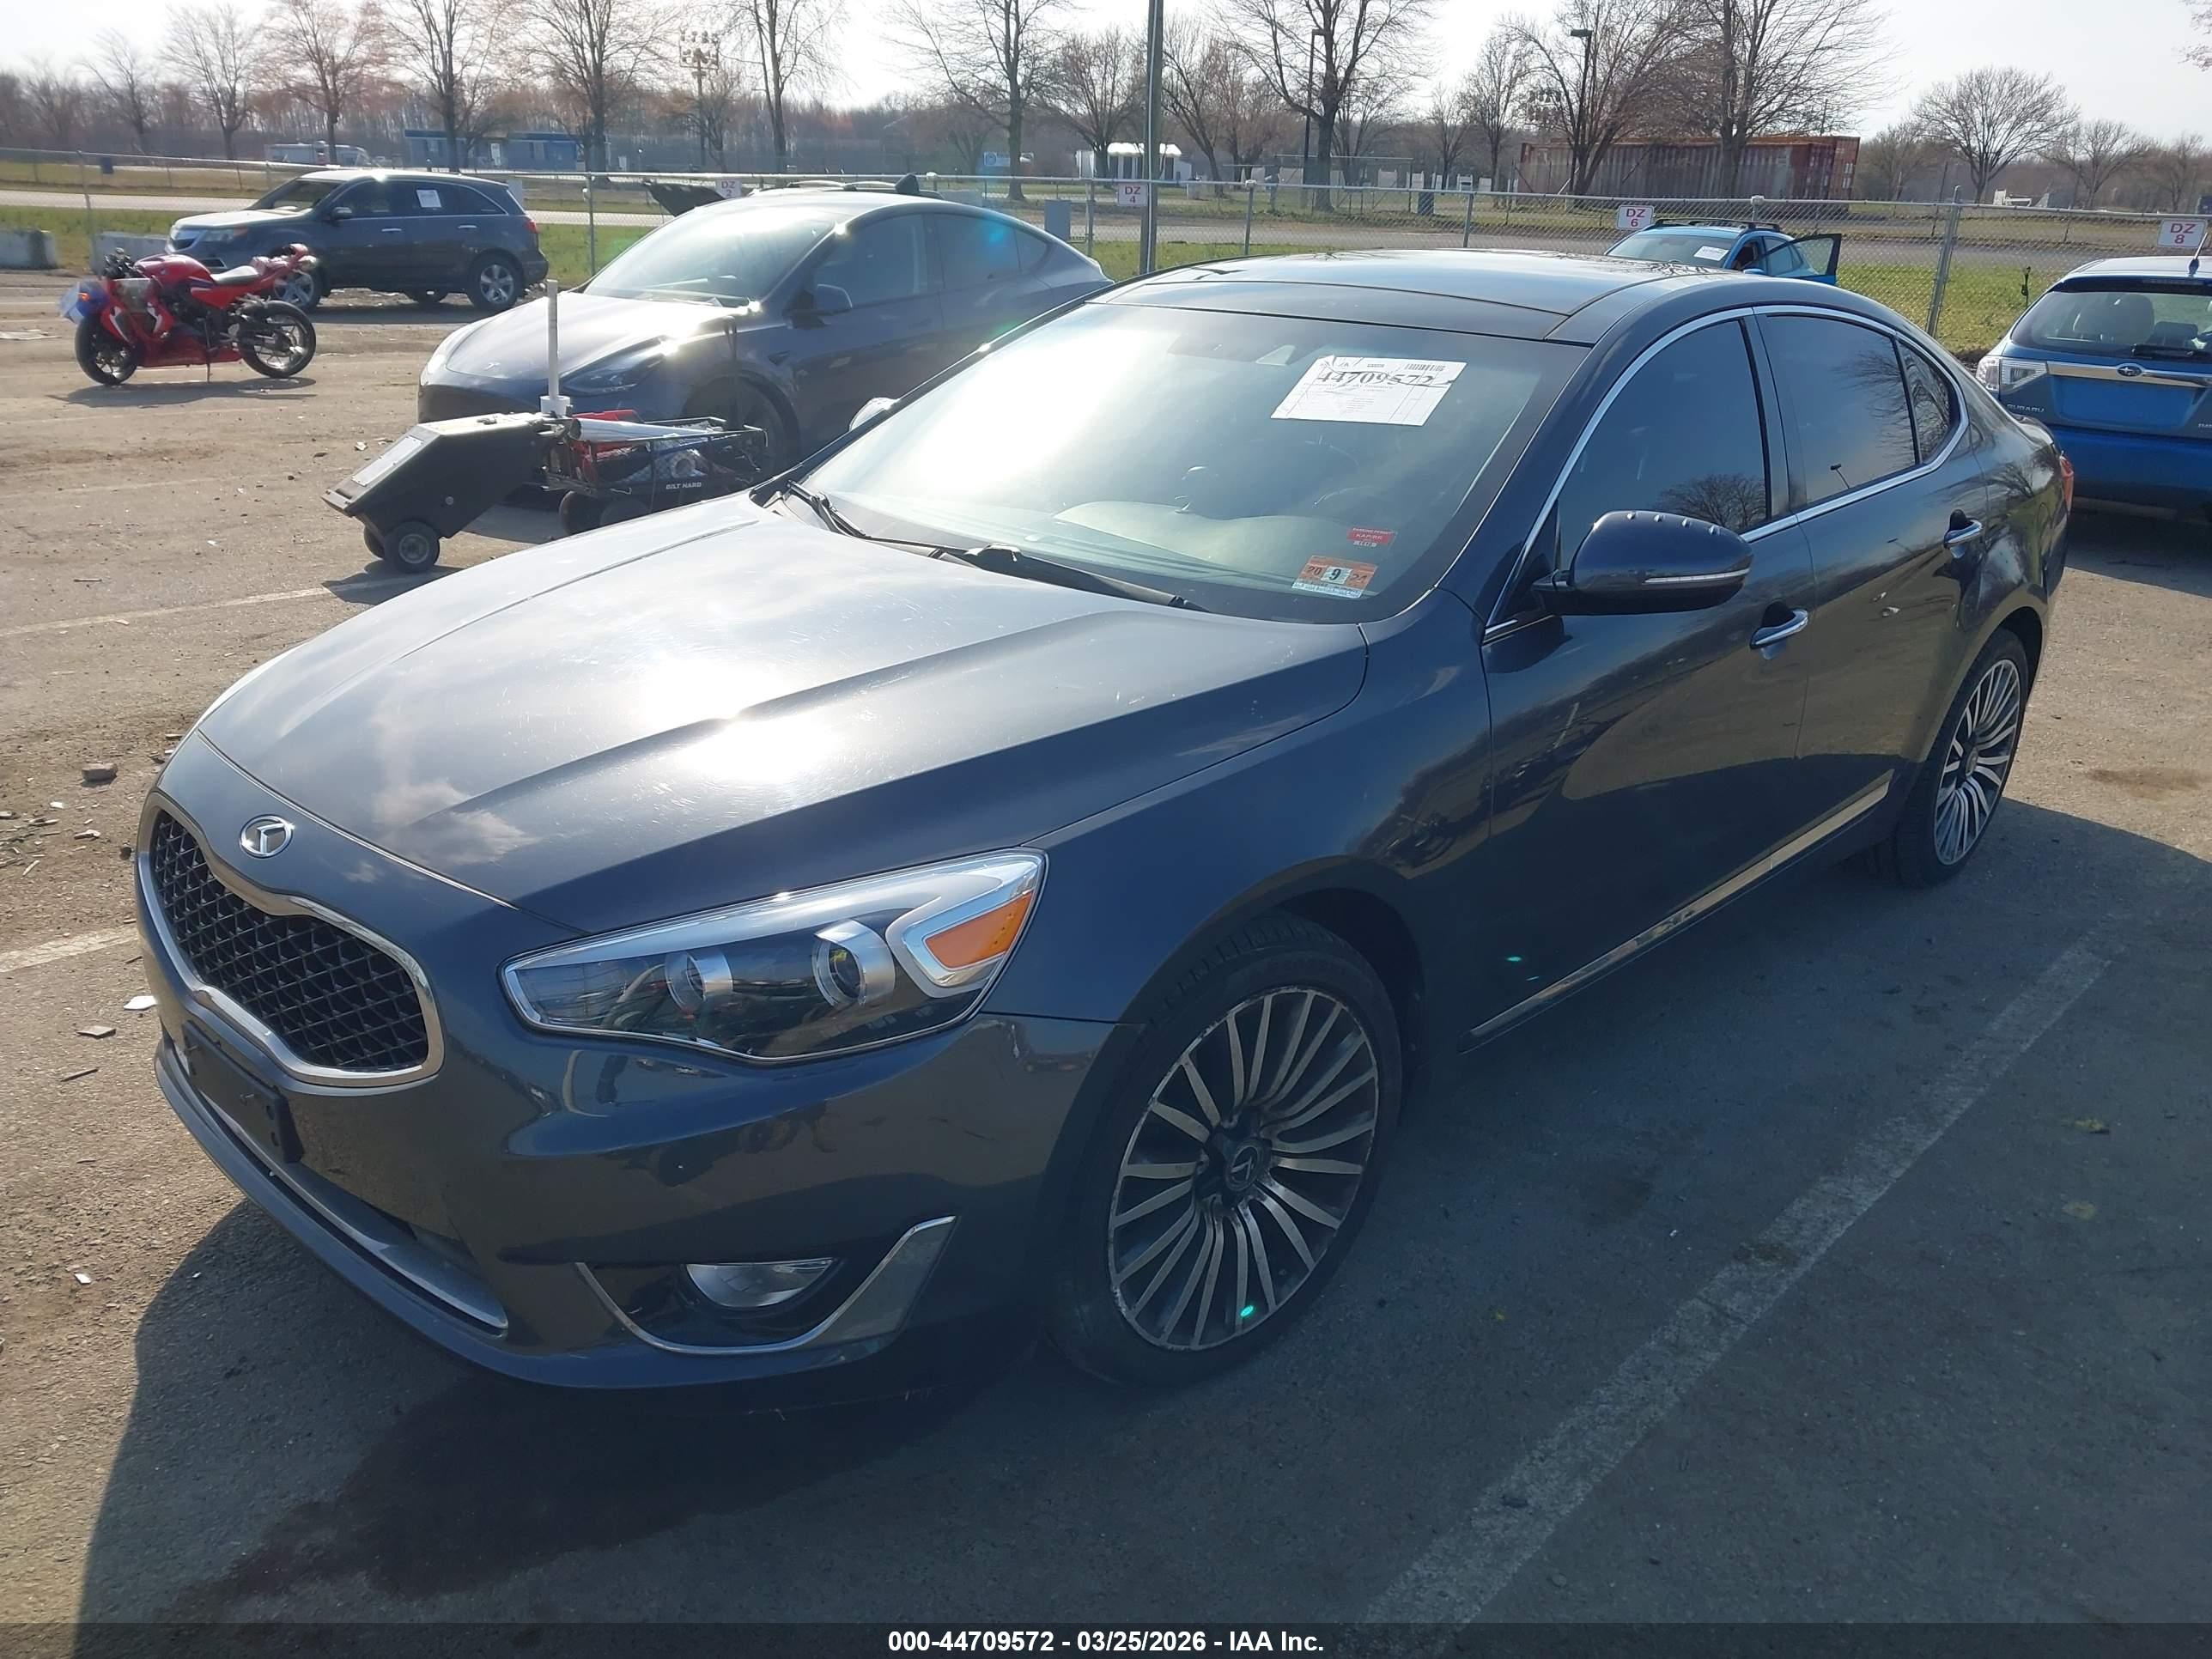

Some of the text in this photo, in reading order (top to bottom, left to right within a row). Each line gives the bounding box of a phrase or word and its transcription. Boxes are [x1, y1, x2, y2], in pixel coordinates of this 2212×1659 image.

[721, 180, 736, 189] DZ
[1125, 186, 1141, 195] DZ
[1626, 208, 1646, 217] DZ
[1631, 218, 1638, 228] 6
[2170, 223, 2196, 234] DZ
[2174, 234, 2185, 244] 8
[1308, 566, 1322, 576] 20
[1328, 568, 1341, 581] 9
